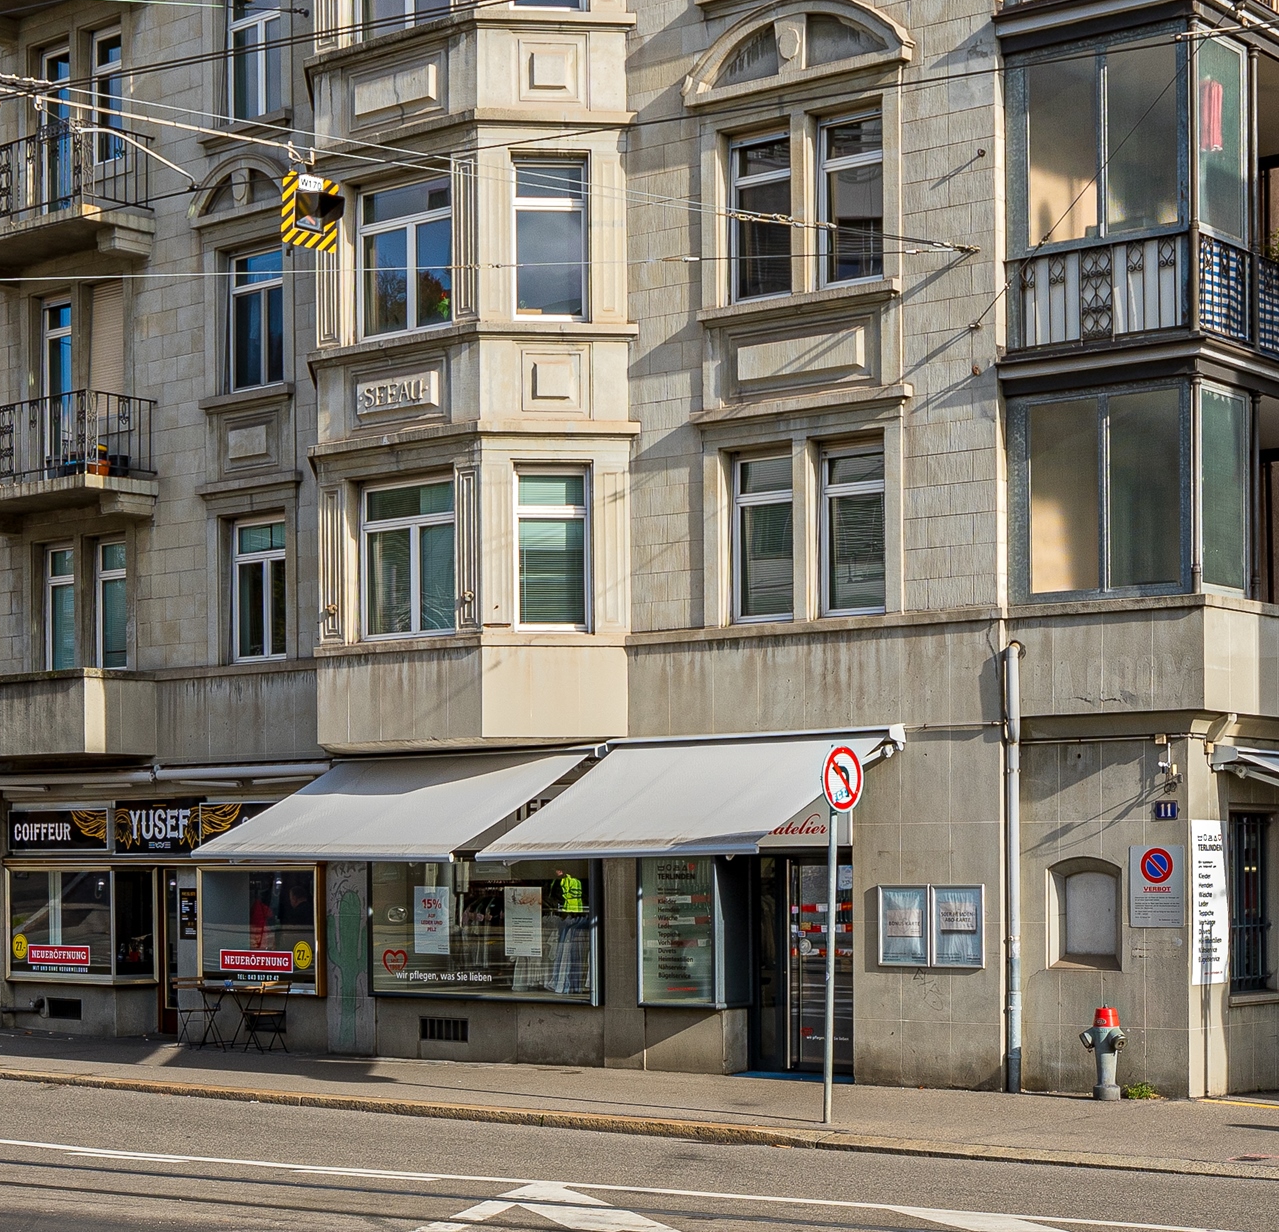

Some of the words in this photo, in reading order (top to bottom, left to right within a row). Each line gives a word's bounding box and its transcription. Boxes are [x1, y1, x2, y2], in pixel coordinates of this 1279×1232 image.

[300, 178, 322, 190] W170
[1160, 804, 1172, 817] 11
[129, 809, 190, 840] YUSEF
[14, 824, 71, 842] COIFFEUR
[422, 899, 442, 909] 15%
[16, 942, 26, 951] 27.-
[32, 949, 86, 960] NEUERÖFFNUNG
[297, 950, 309, 961] 27.-
[224, 955, 289, 967] NEUERÖFFNUNG
[396, 970, 408, 979] wir
[410, 970, 438, 982] pflegen,
[440, 973, 455, 981] was
[457, 972, 468, 981] Sie
[469, 972, 492, 982] lieben
